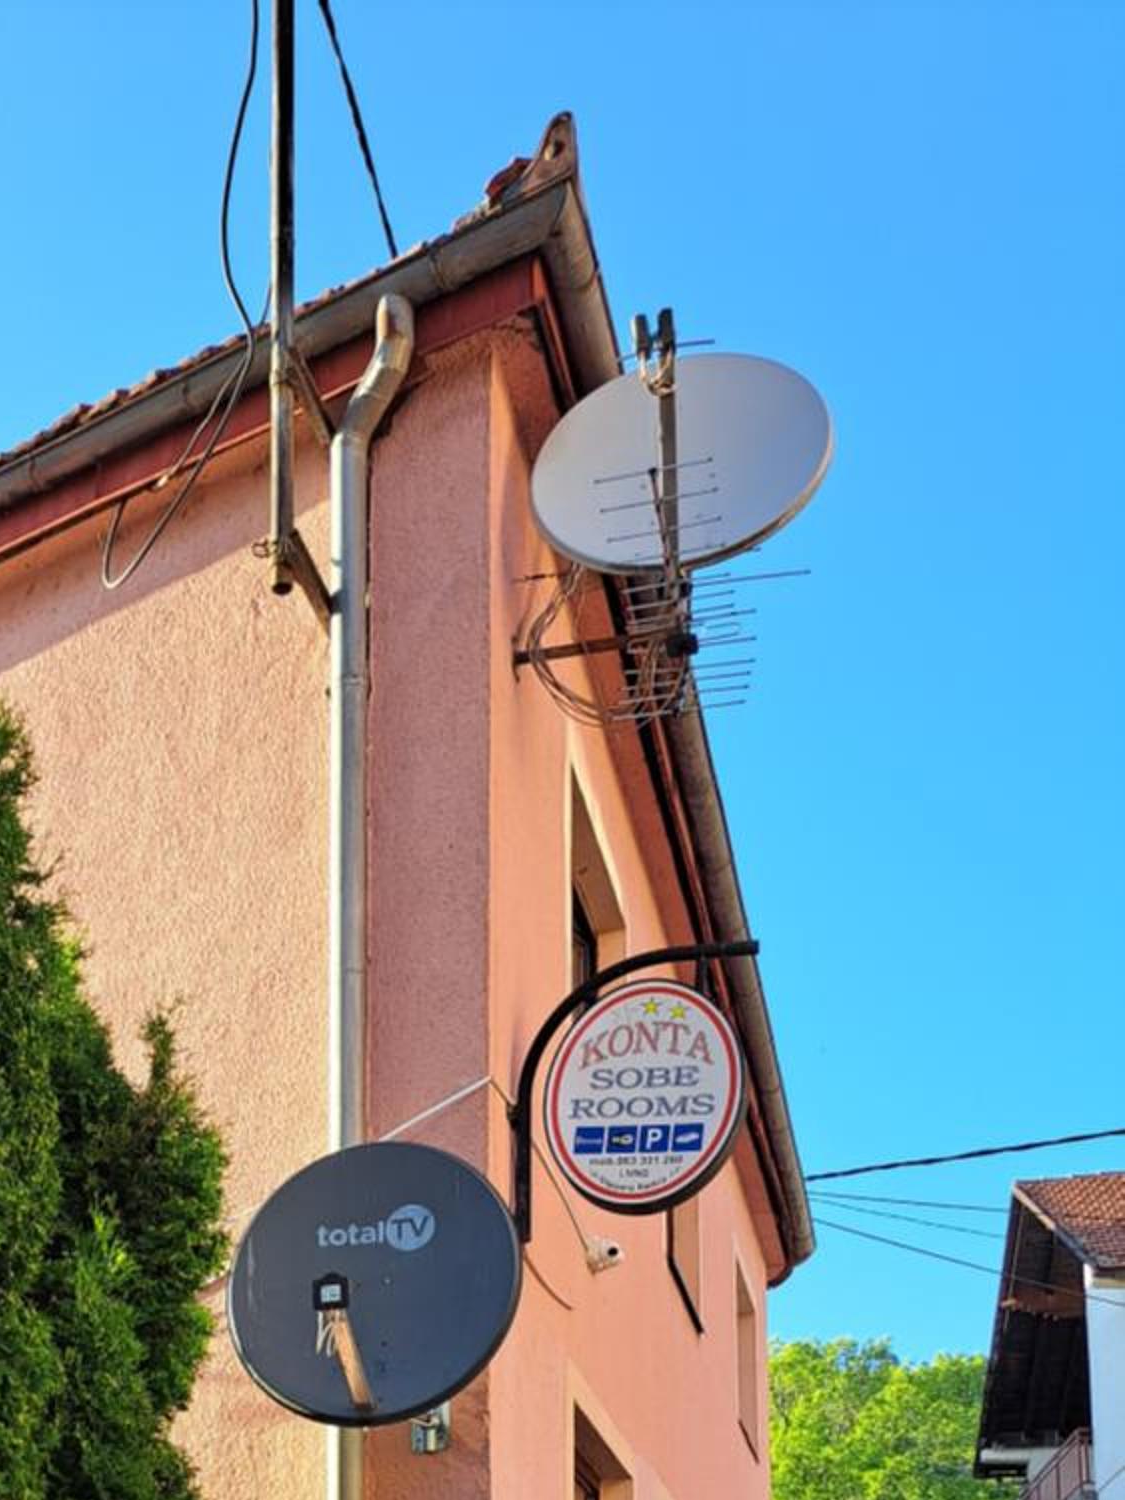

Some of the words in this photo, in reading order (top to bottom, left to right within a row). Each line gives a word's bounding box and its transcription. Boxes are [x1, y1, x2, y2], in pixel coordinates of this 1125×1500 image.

[580, 1021, 713, 1069] KONTA
[590, 1066, 700, 1090] SOBE
[569, 1095, 715, 1119] ROOMS
[646, 1129, 663, 1150] P
